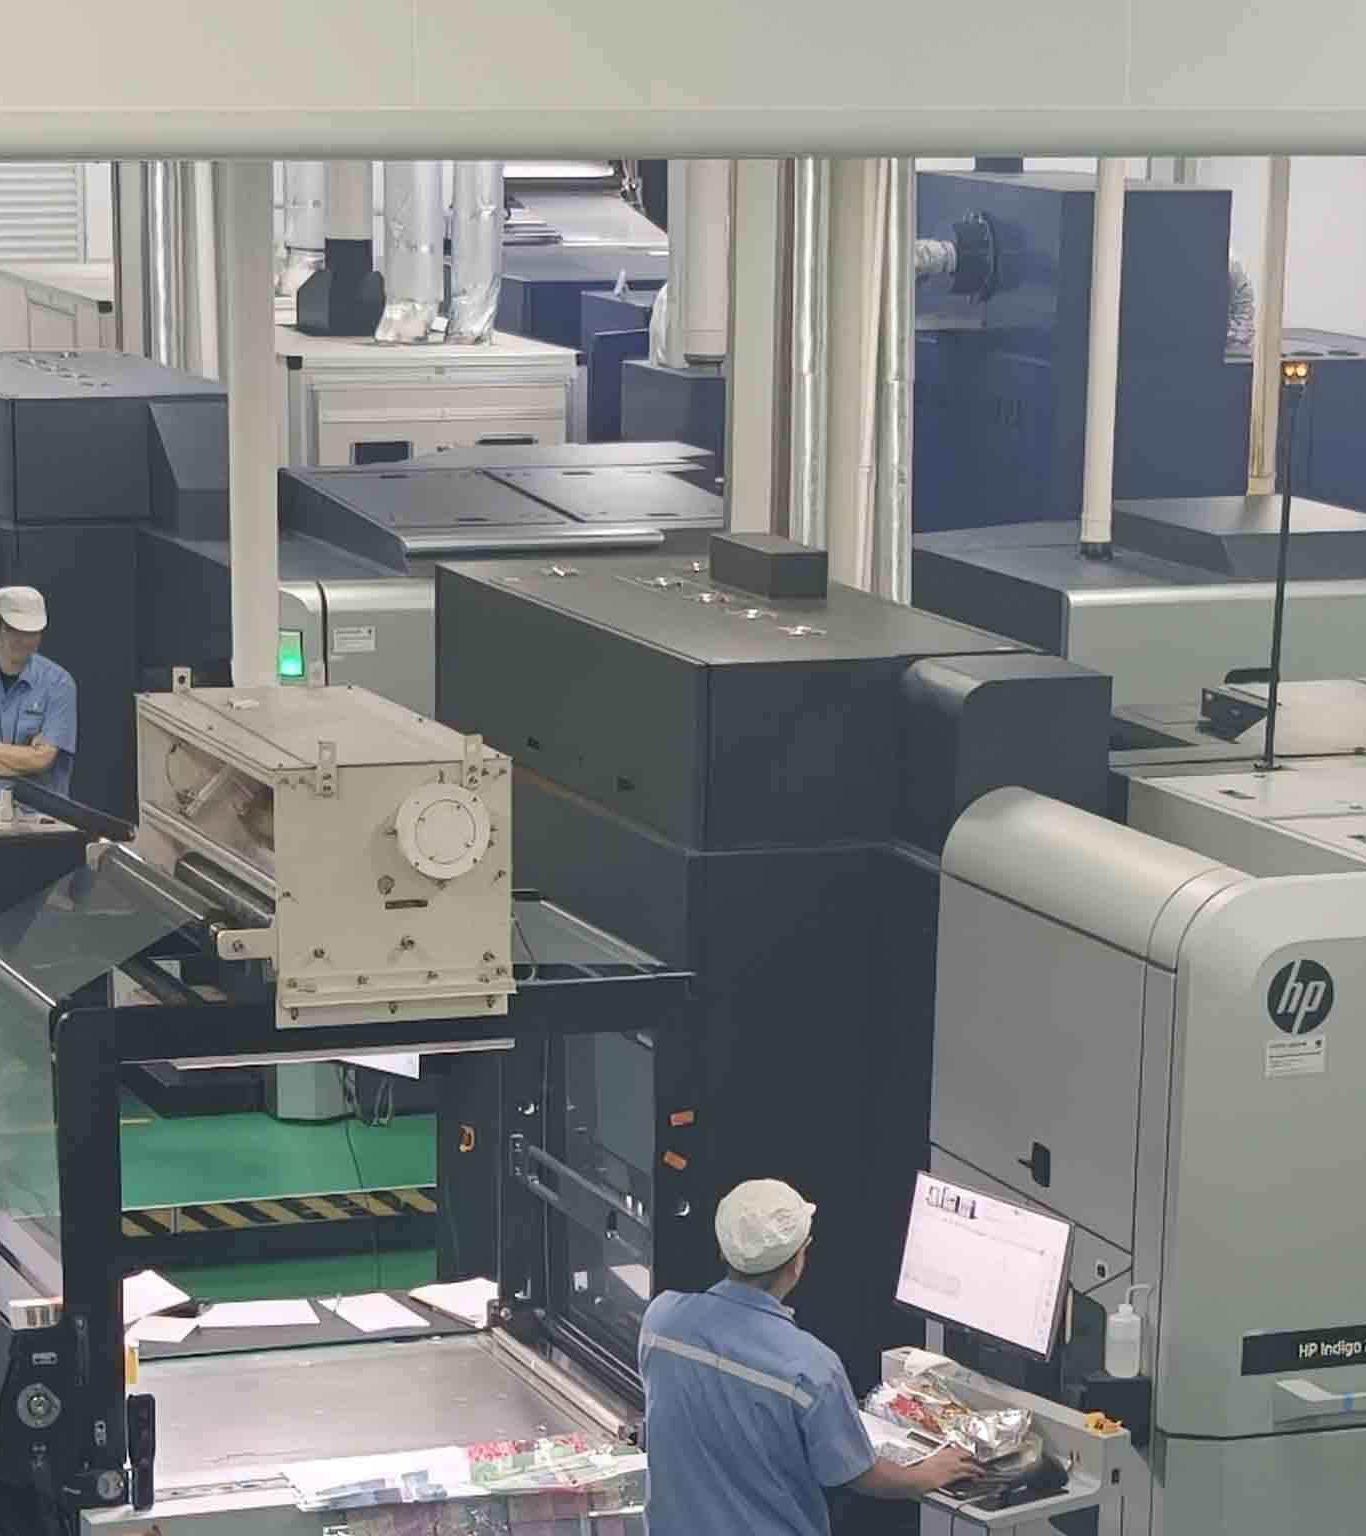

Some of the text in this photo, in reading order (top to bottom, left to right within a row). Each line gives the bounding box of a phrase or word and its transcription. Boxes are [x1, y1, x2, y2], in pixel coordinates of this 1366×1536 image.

[1275, 960, 1327, 1037] hp
[1298, 1342, 1318, 1359] HP
[1320, 1339, 1362, 1357] Indigo
